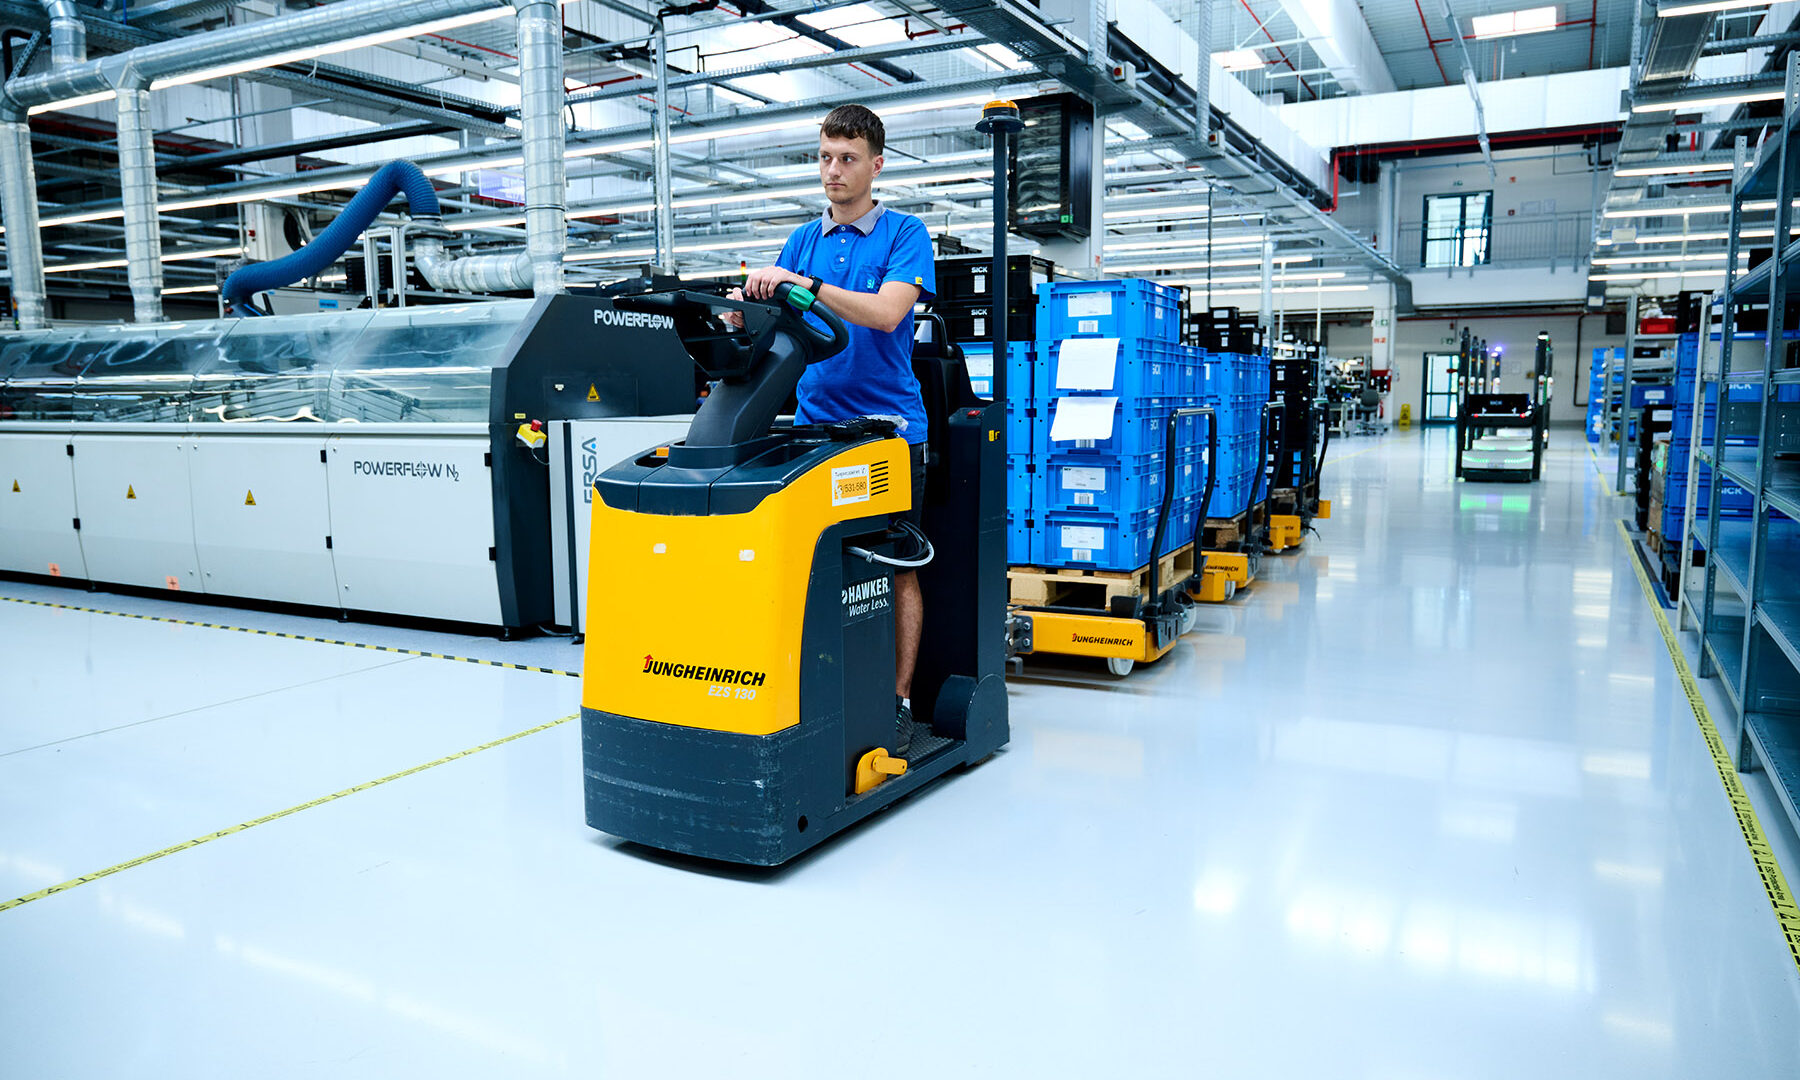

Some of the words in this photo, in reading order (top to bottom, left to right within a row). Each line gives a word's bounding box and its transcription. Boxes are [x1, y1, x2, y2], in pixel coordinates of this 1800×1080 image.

[594, 309, 674, 330] POWERFLOW
[971, 308, 988, 316] SICK
[353, 460, 443, 479] POWERFLOW
[582, 437, 597, 503] ERSA
[848, 577, 890, 604] HAWKER
[849, 603, 870, 617] Water
[1072, 635, 1133, 647] JUNGHEINRICH
[643, 658, 766, 687] JUNGHEINRICH
[708, 685, 731, 698] EZS
[734, 687, 757, 701] 130
